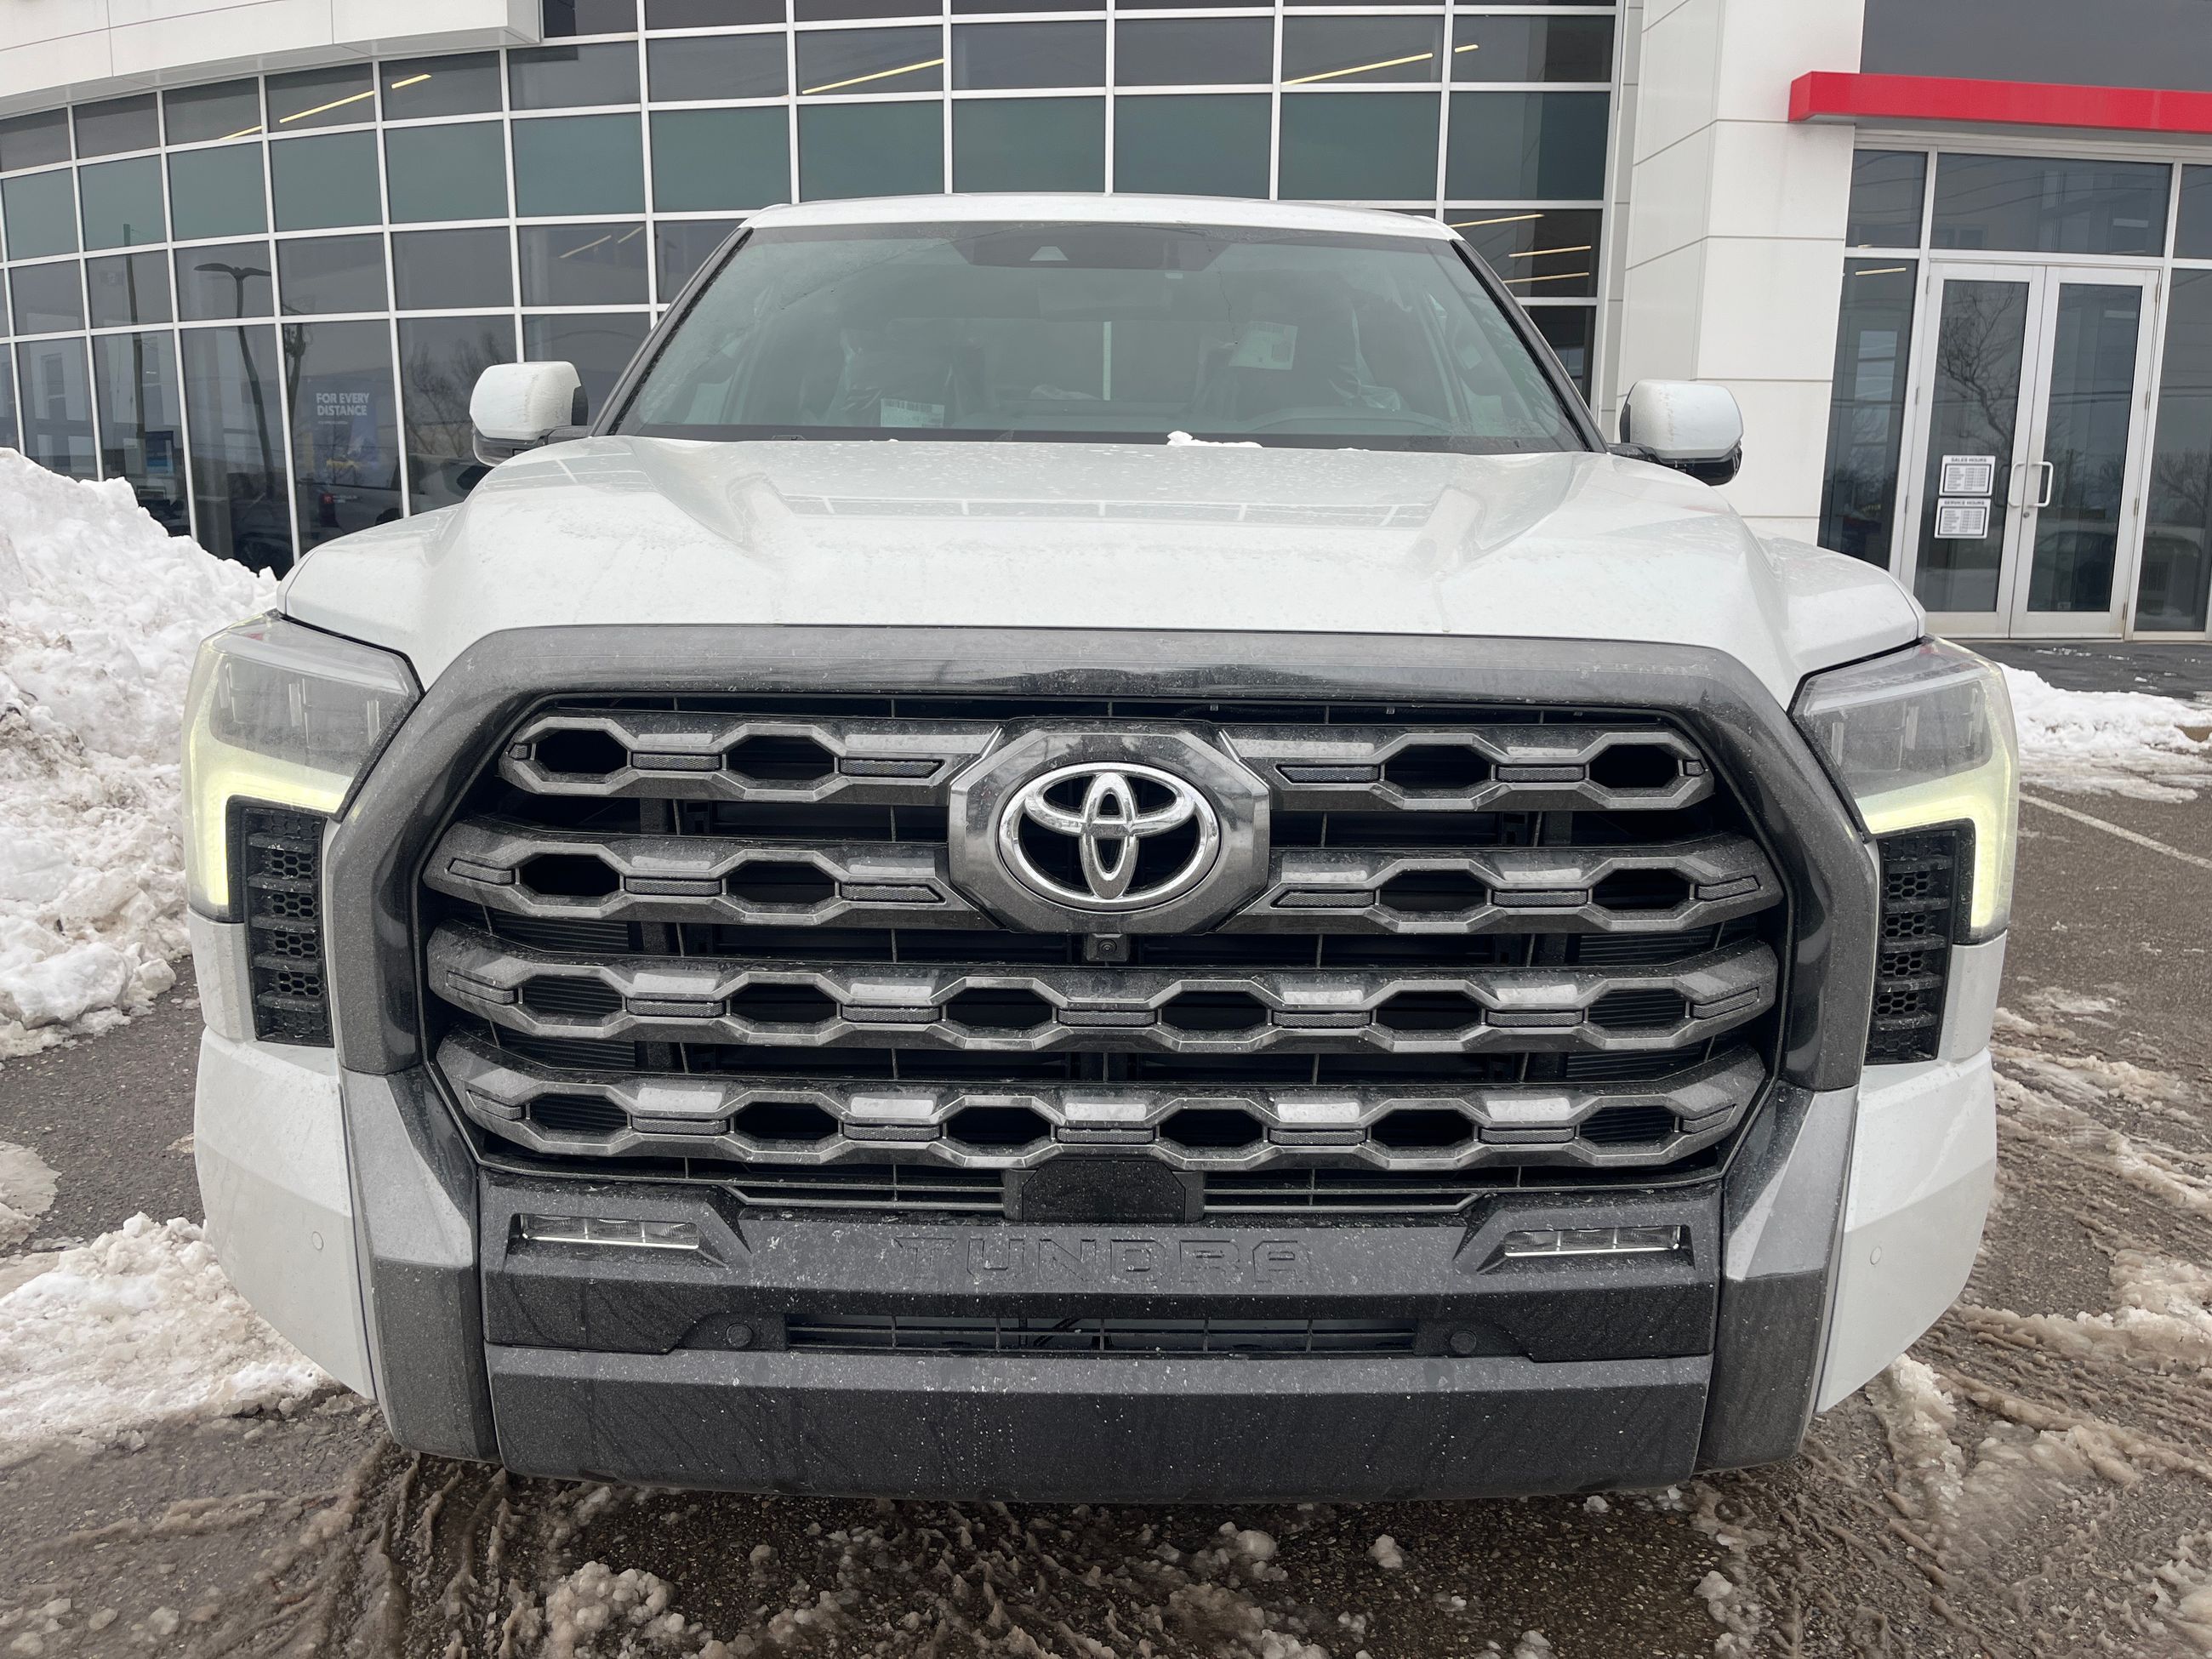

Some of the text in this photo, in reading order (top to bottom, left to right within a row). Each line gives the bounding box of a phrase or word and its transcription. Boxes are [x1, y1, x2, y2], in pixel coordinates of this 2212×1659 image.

[316, 393, 369, 403] FOR EVERY
[316, 405, 368, 416] DISTANCE
[892, 1236, 1313, 1283] TUNDRA
